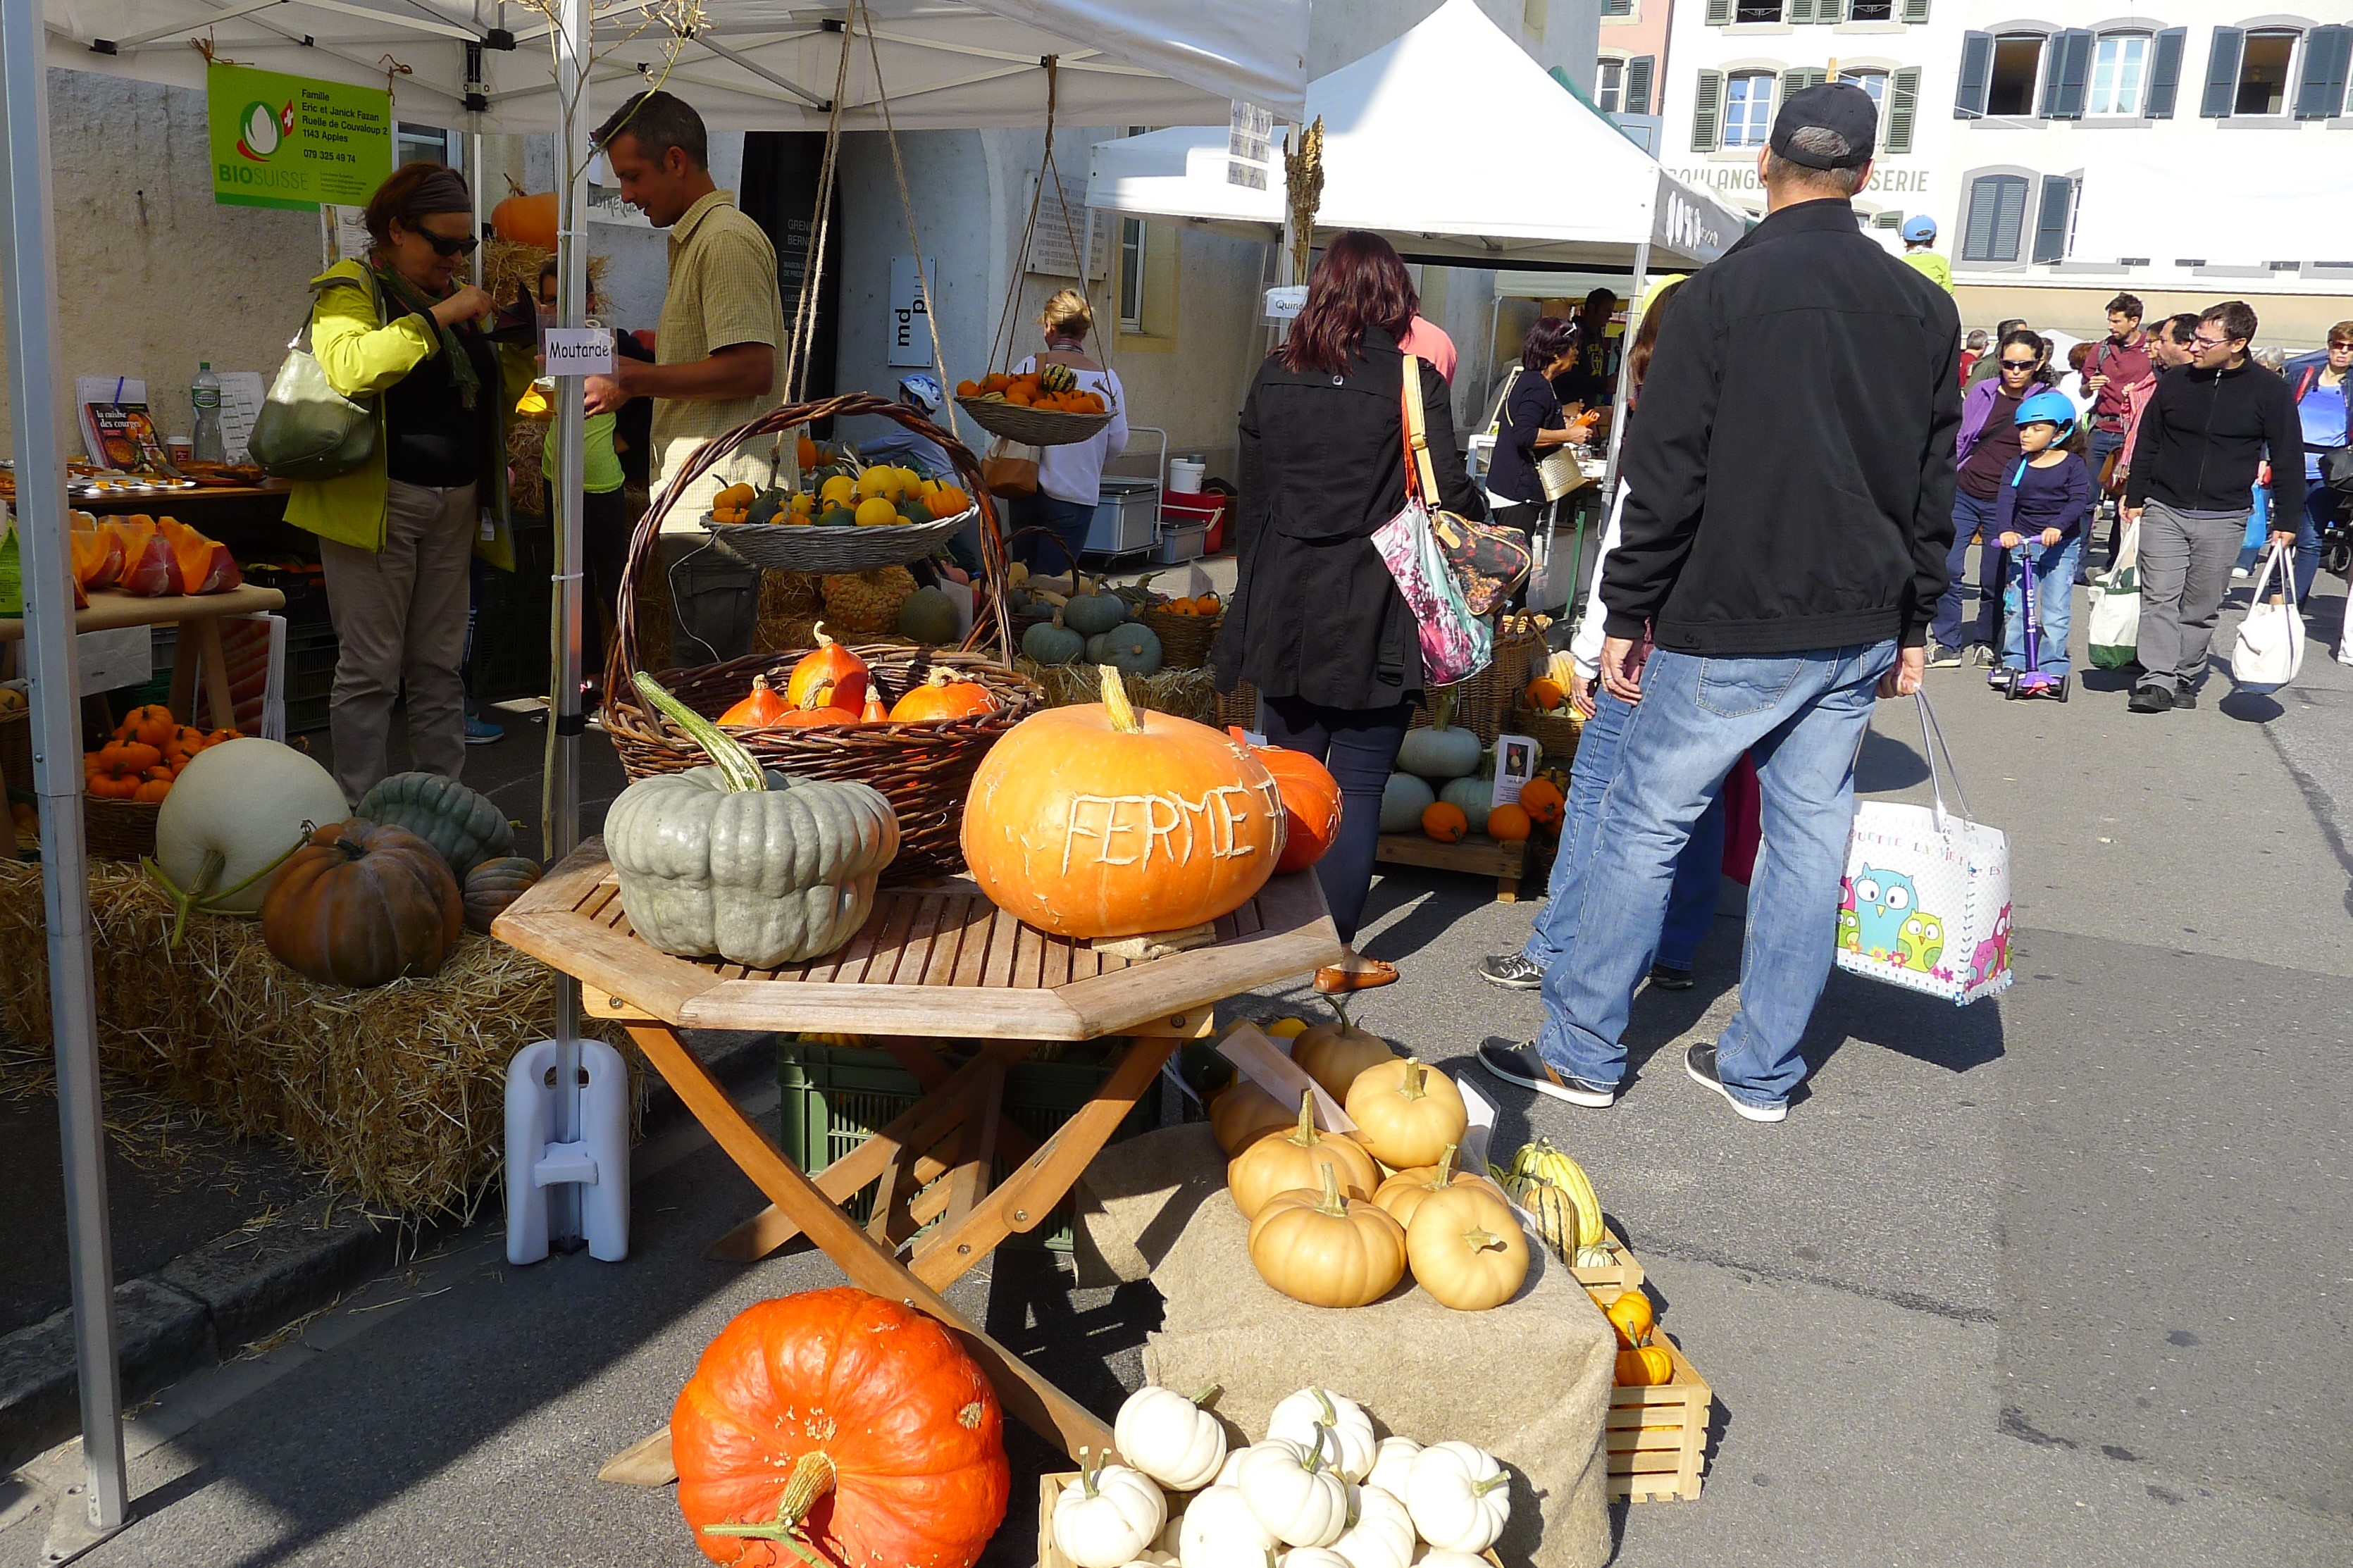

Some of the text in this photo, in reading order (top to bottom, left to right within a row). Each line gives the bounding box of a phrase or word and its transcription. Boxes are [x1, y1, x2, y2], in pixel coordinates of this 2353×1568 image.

[302, 89, 330, 101] Famille
[302, 102, 379, 121] Eric et Janick Fazan
[302, 115, 387, 136] Ruelle de Couvaloup 2
[303, 129, 349, 143] 1143 Apples
[304, 149, 356, 163] 079 325 49 74
[1868, 170, 1929, 192] SERIE
[550, 340, 609, 359] Moutarde
[100, 418, 142, 430] des courges
[1061, 778, 1255, 879] FERME
